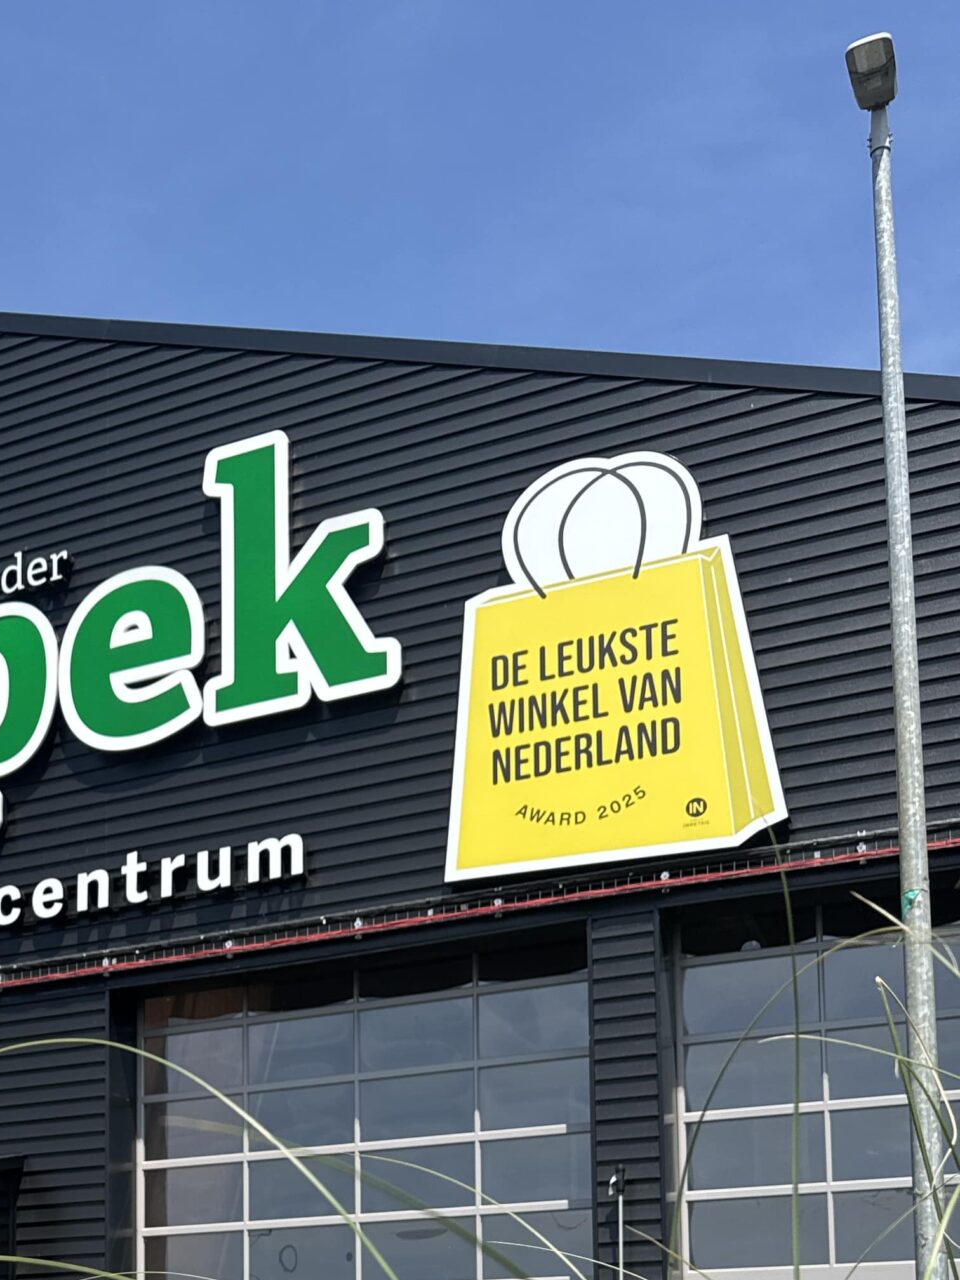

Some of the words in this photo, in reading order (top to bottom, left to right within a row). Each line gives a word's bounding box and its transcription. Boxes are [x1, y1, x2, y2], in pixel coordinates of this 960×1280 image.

[0, 549, 69, 591] der
[491, 650, 528, 691] DE
[538, 619, 680, 682] LEUKSTE
[487, 684, 609, 738] WINKEL
[618, 666, 682, 713] VAN
[491, 717, 681, 785] NEDERLAND
[514, 804, 587, 826] AWARD
[597, 786, 648, 820] 2025
[688, 800, 704, 815] IN
